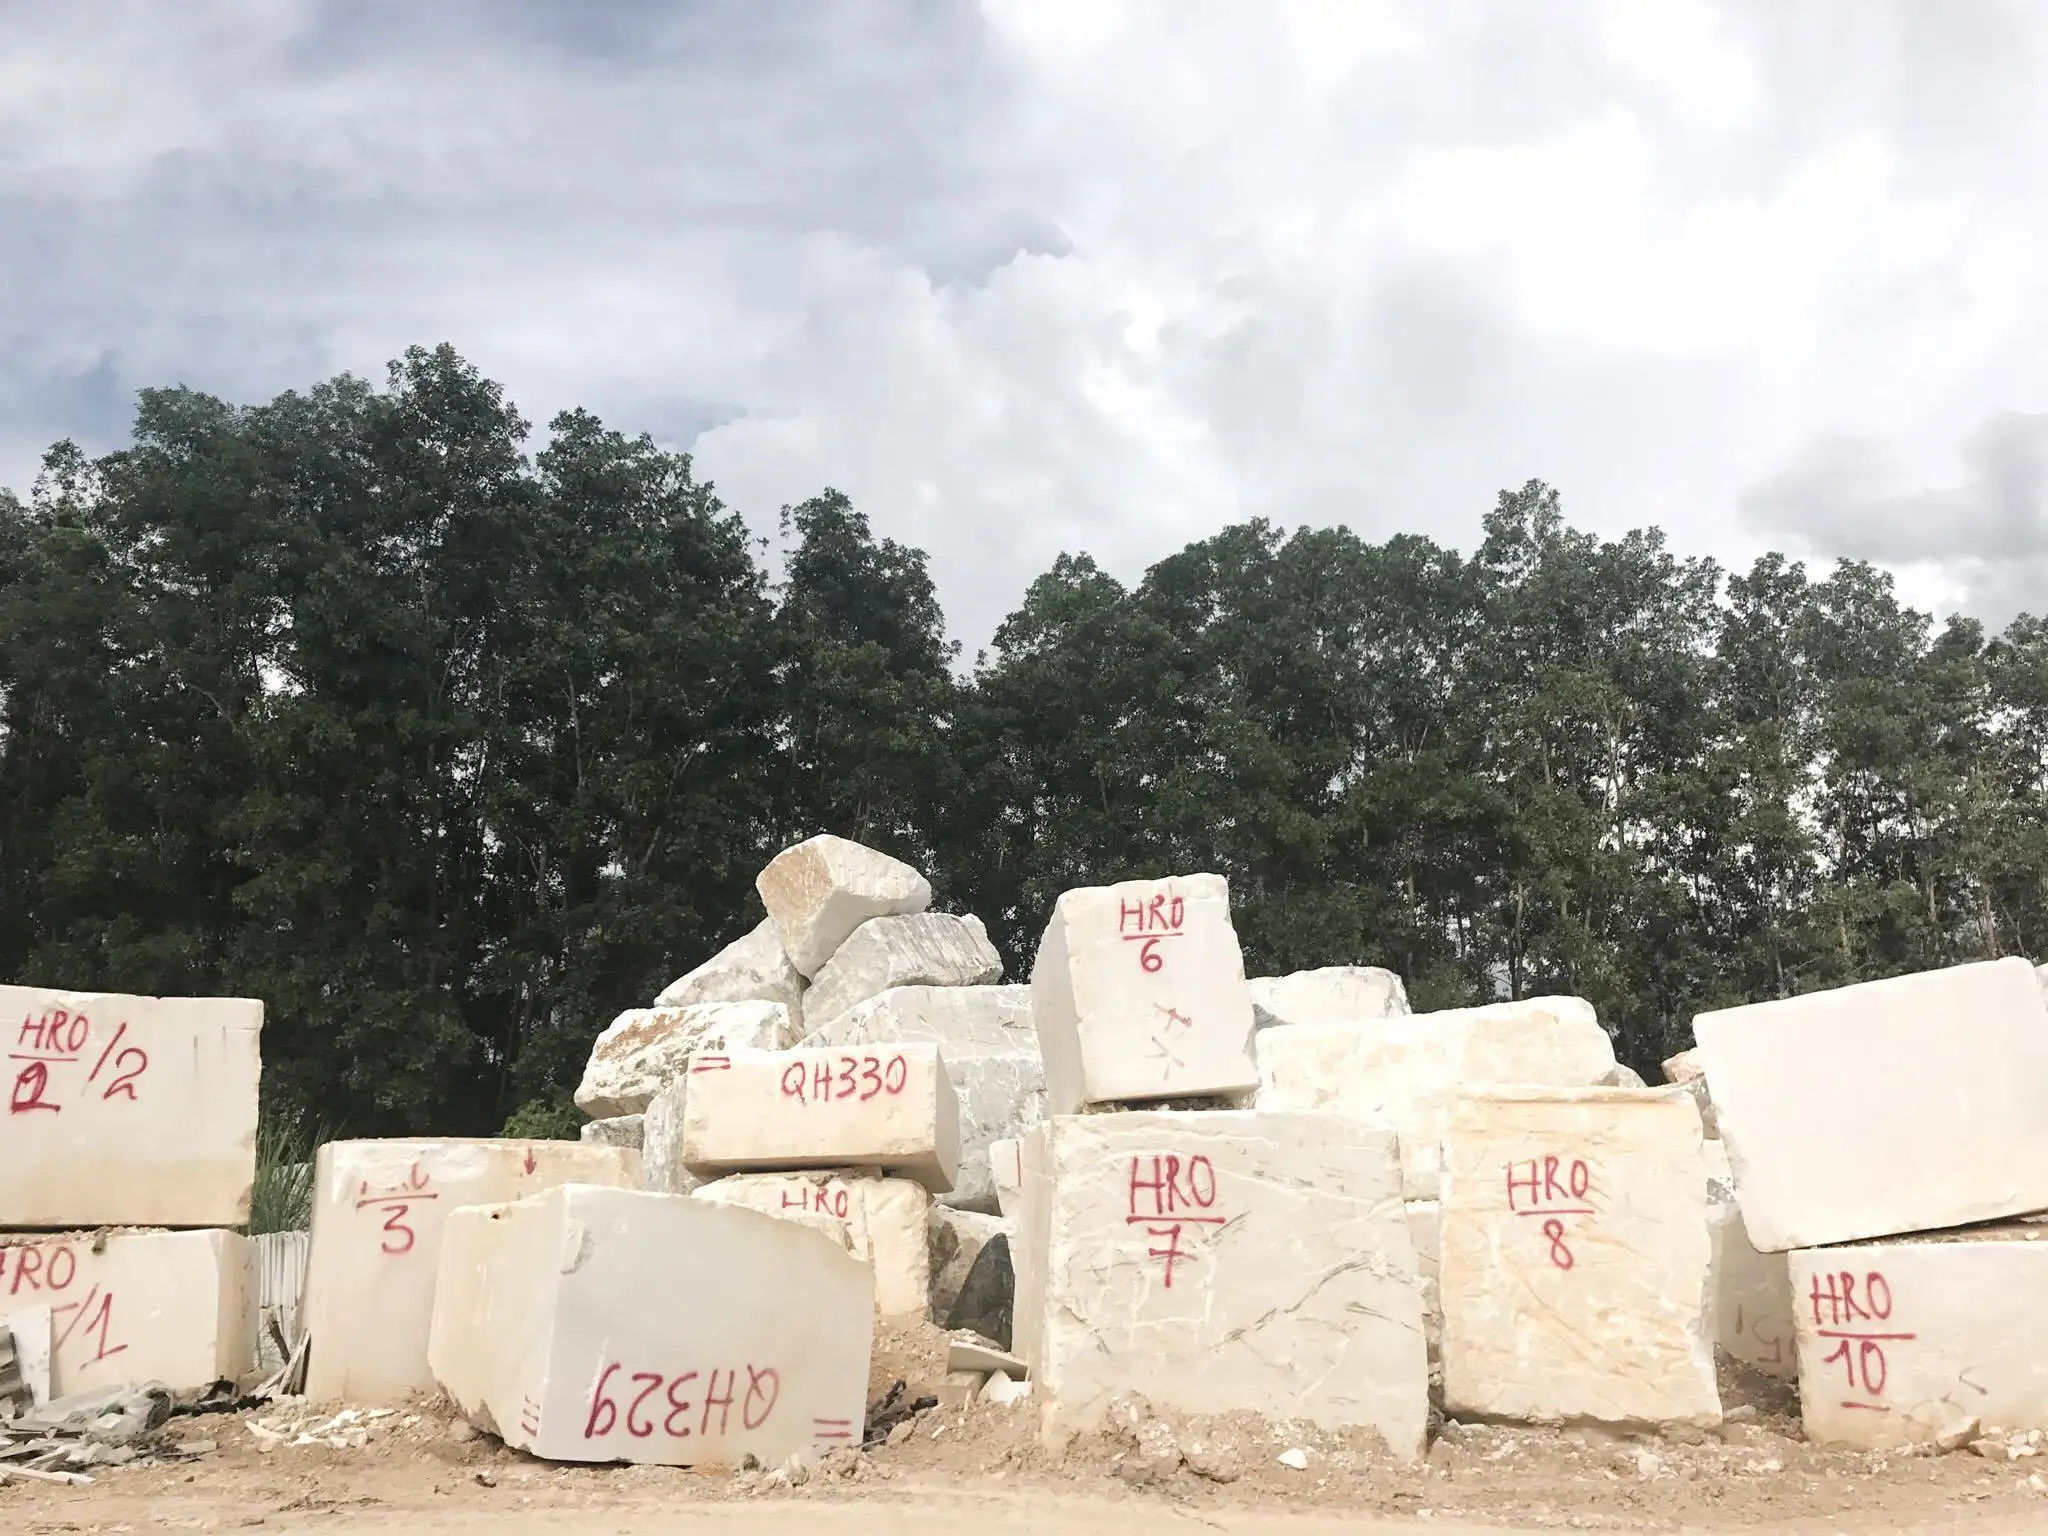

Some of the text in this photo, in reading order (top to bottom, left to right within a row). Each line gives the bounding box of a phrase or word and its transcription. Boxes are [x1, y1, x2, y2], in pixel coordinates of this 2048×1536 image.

[1119, 894, 1184, 932] HRO
[1139, 938, 1163, 973] 6
[18, 1010, 90, 1056] HRO
[780, 1055, 908, 1105] QH330
[1130, 1154, 1216, 1215] HRO
[1505, 1156, 1590, 1211] HRO
[381, 1204, 415, 1255] 3
[1147, 1223, 1198, 1289] 7
[1543, 1218, 1574, 1271] 8
[0, 1246, 76, 1295] RO
[1809, 1270, 1893, 1325] HRO
[1822, 1339, 1887, 1396] 10
[583, 1362, 780, 1439] QH329
